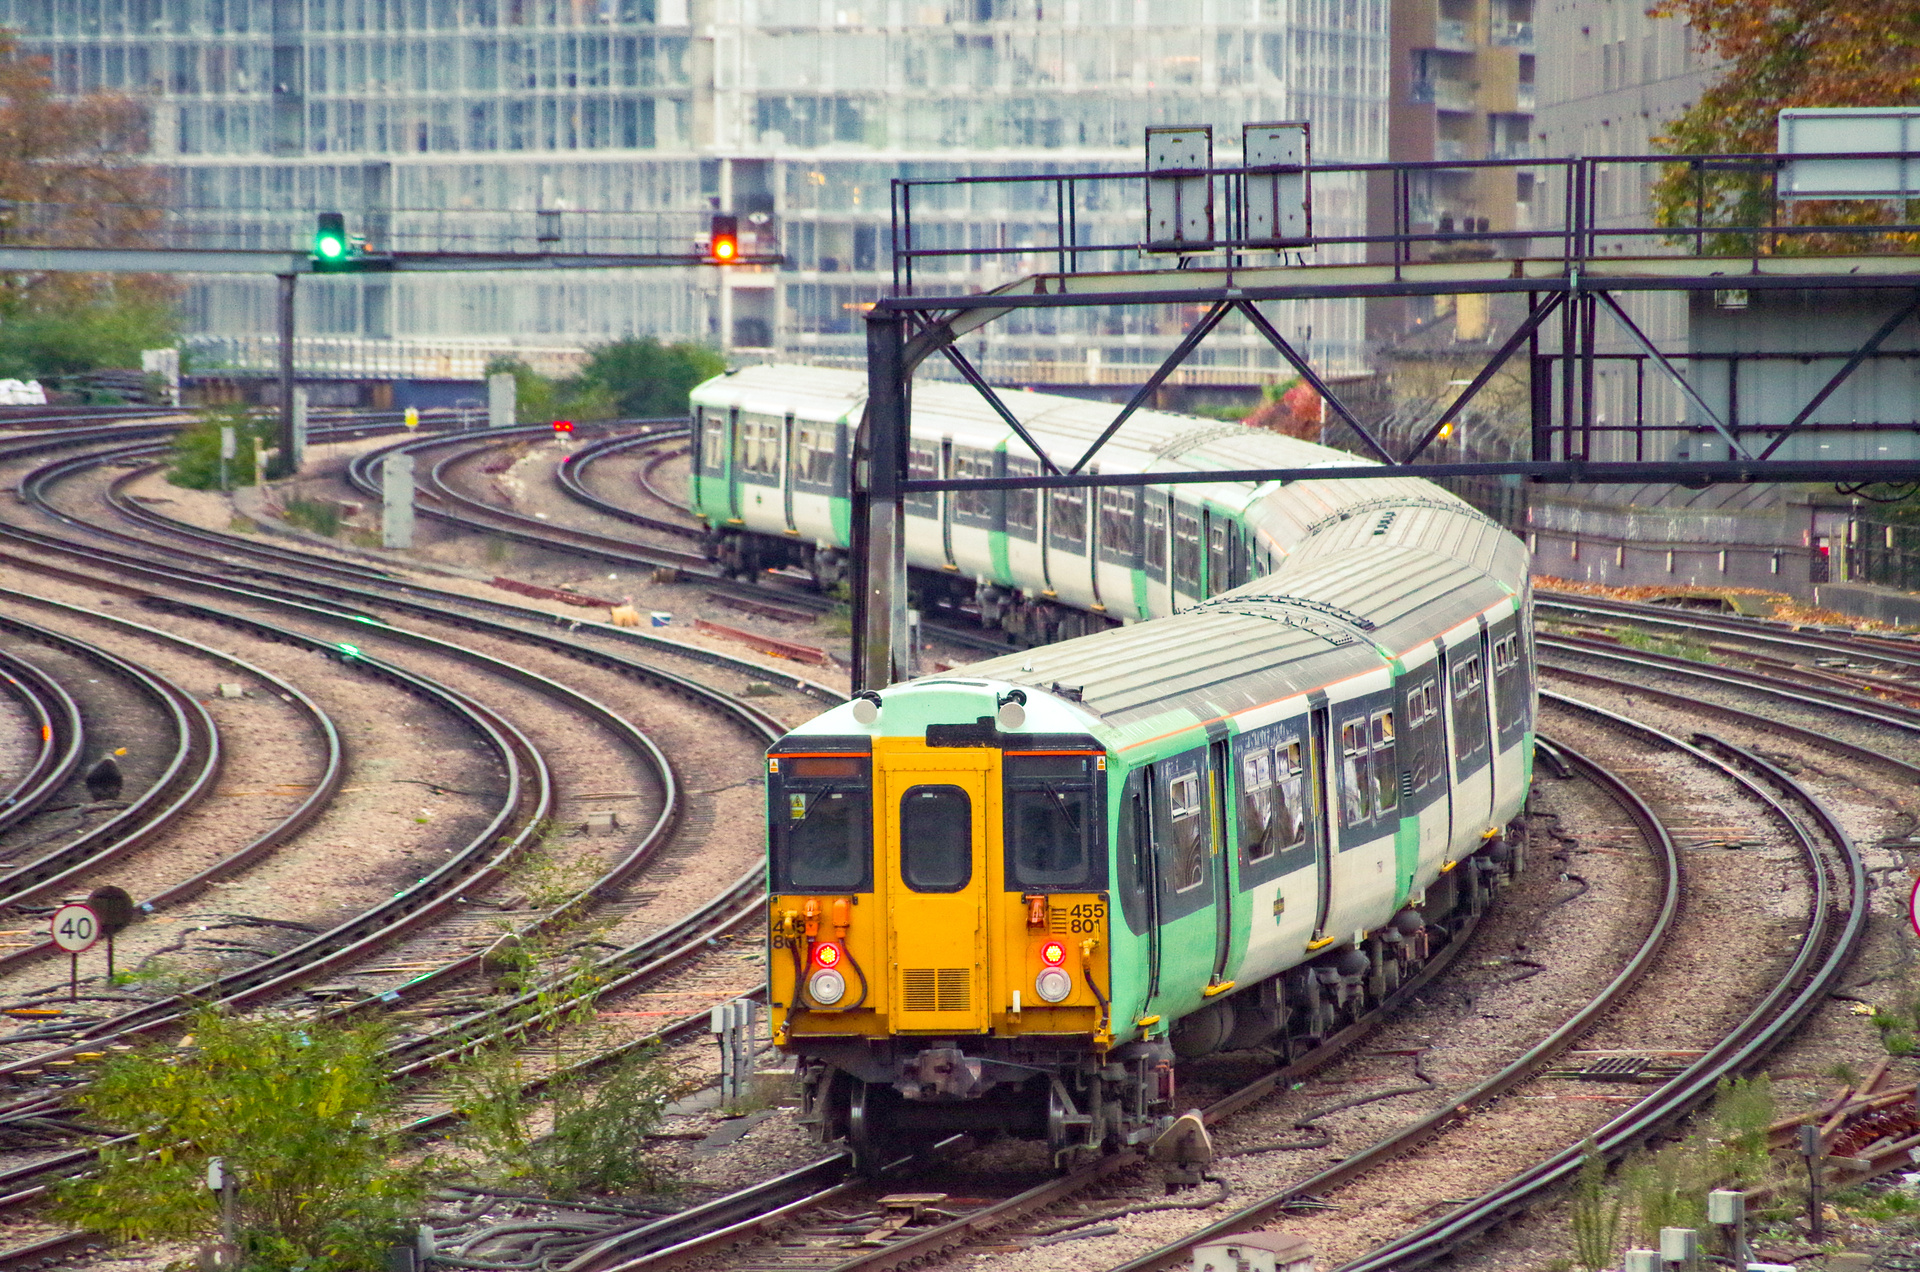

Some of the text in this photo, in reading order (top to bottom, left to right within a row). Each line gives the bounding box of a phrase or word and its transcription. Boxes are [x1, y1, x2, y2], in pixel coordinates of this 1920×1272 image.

[1070, 904, 1105, 918] 455
[60, 917, 92, 940] 40
[773, 918, 806, 934] 45
[1071, 919, 1101, 933] 801
